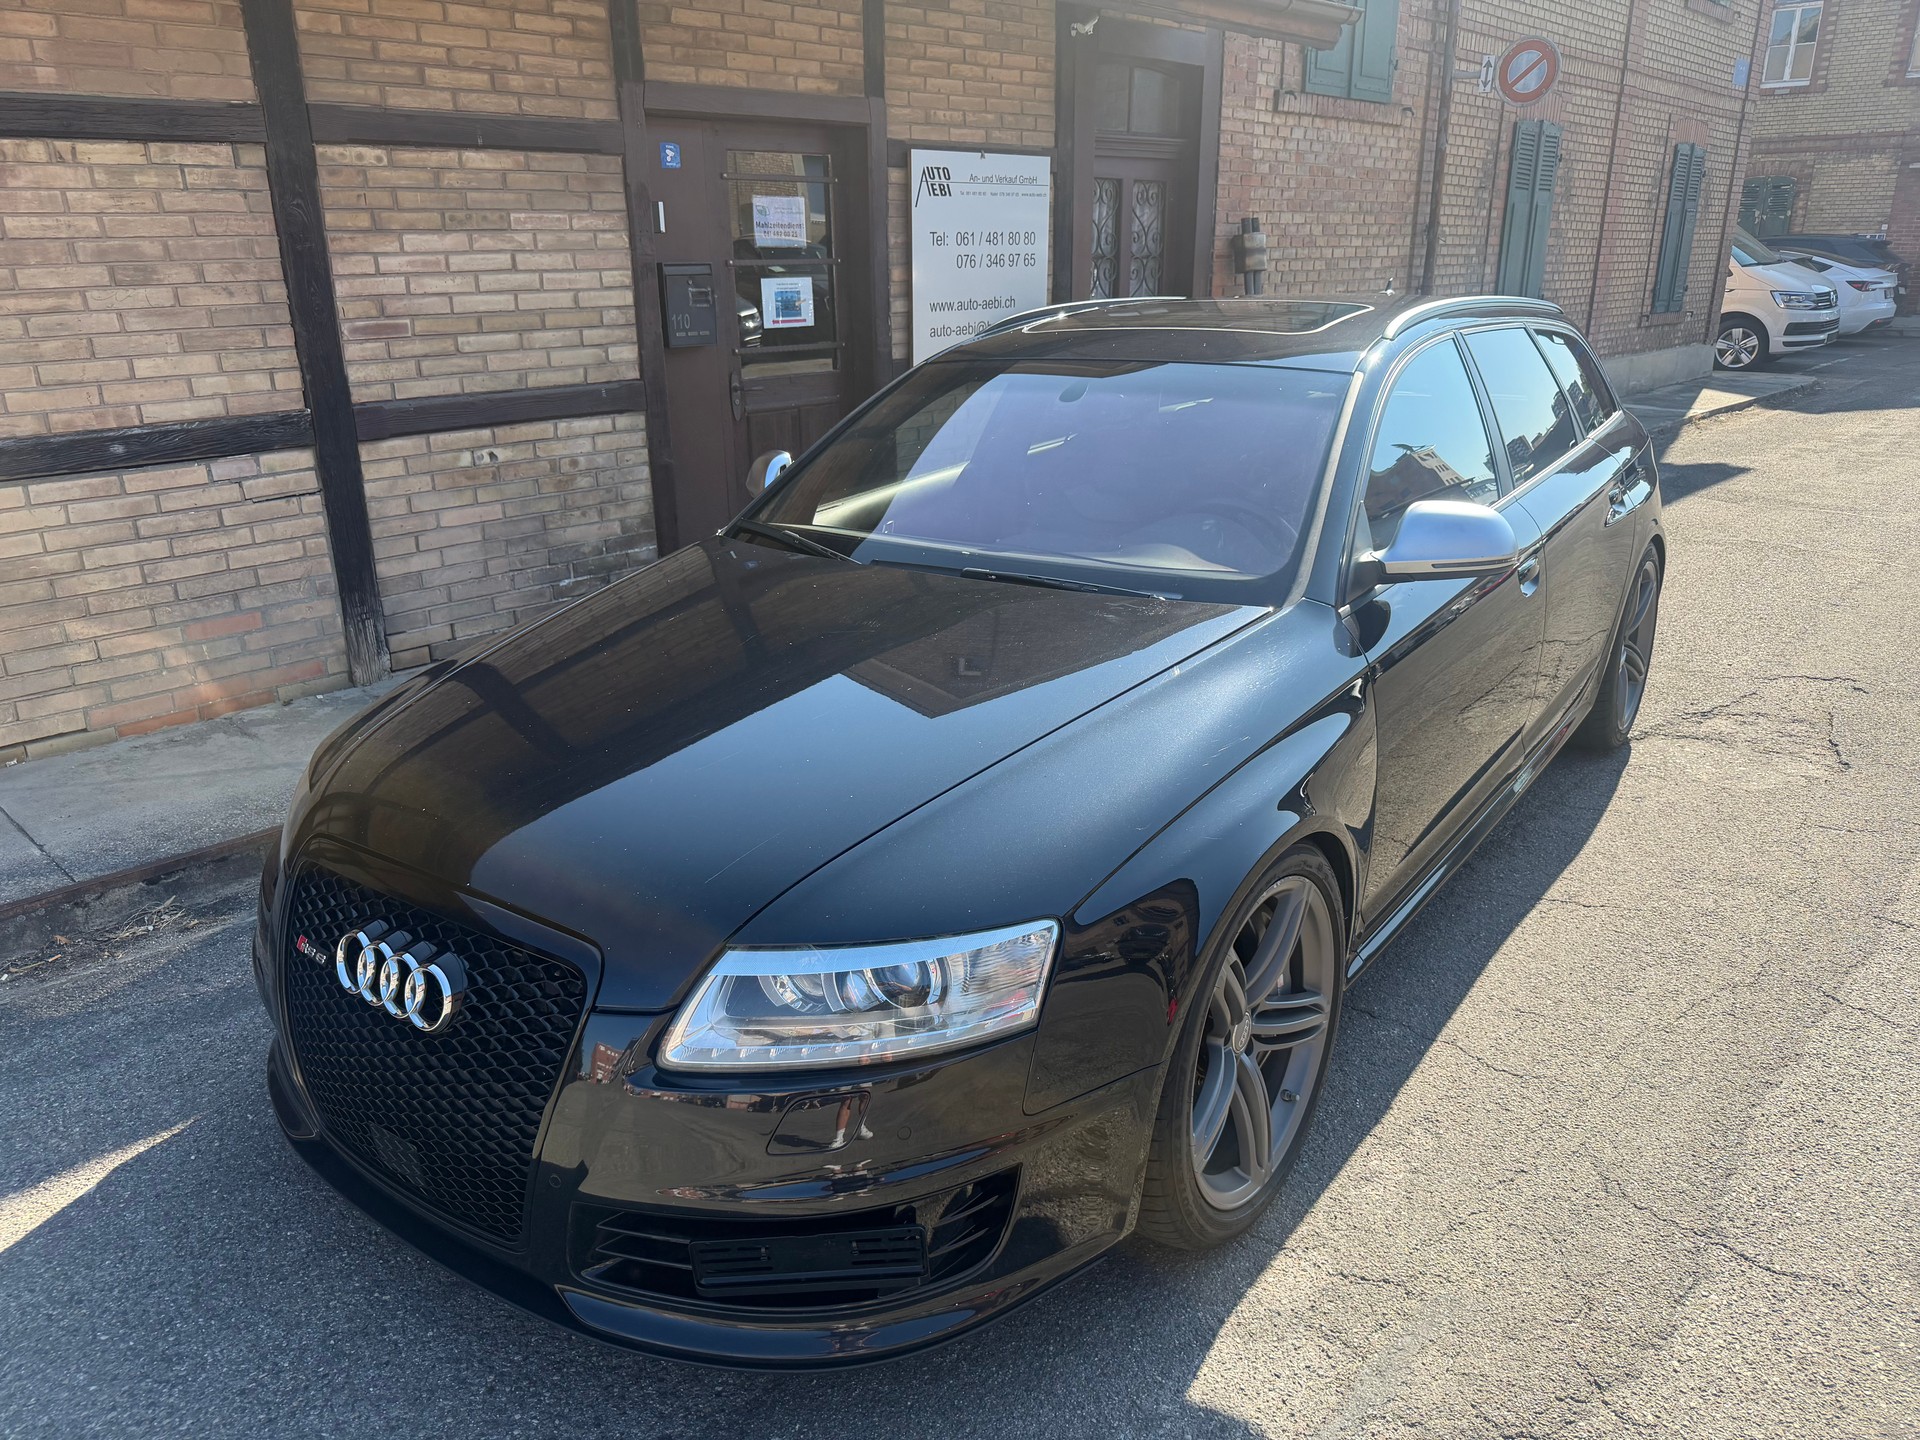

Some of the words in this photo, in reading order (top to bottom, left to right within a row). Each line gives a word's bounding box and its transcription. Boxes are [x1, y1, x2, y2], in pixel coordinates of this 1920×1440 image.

[969, 173, 980, 182] An-
[982, 174, 994, 183] und
[995, 174, 1017, 184] Verkauf
[1019, 175, 1038, 184] GmbH
[929, 231, 949, 246] Tel:
[955, 231, 975, 246] 061
[978, 231, 983, 246] /
[985, 231, 1004, 246] 481
[1008, 231, 1020, 246] 80
[1023, 231, 1036, 246] 80
[956, 254, 976, 269] 076
[986, 253, 1005, 268] 346
[1008, 253, 1021, 268] 97
[1023, 253, 1036, 267] 65
[929, 296, 1016, 312] www.auto-aebi.ch
[671, 313, 690, 330] 110
